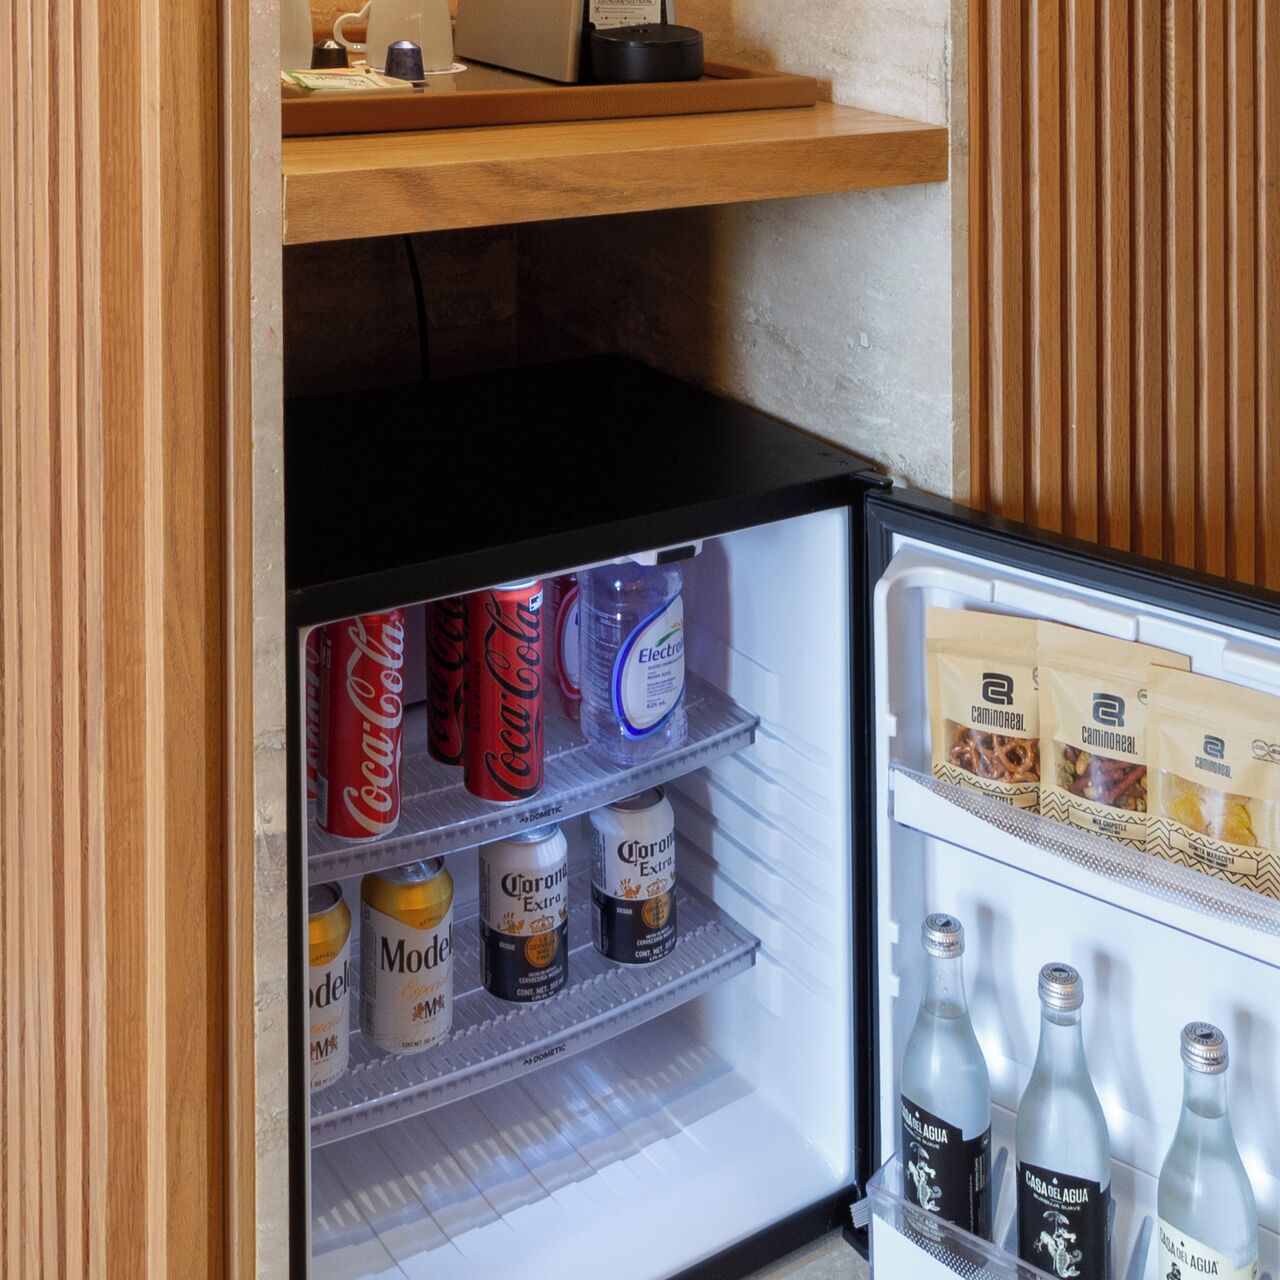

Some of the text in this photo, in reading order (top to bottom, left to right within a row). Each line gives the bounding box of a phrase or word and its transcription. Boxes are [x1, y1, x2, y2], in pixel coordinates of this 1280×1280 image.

[342, 617, 405, 835] Coca-Cola
[530, 805, 563, 821] DOMETIC
[639, 856, 672, 877] Extra
[523, 893, 561, 913] Extra
[381, 923, 454, 973] Model
[533, 1043, 566, 1063] DOMETIC
[923, 1123, 948, 1144] AGUA
[1025, 1170, 1089, 1204] CASA DEL AGUA
[1176, 1247, 1189, 1265] DEL
[1190, 1254, 1218, 1275] AGUA
